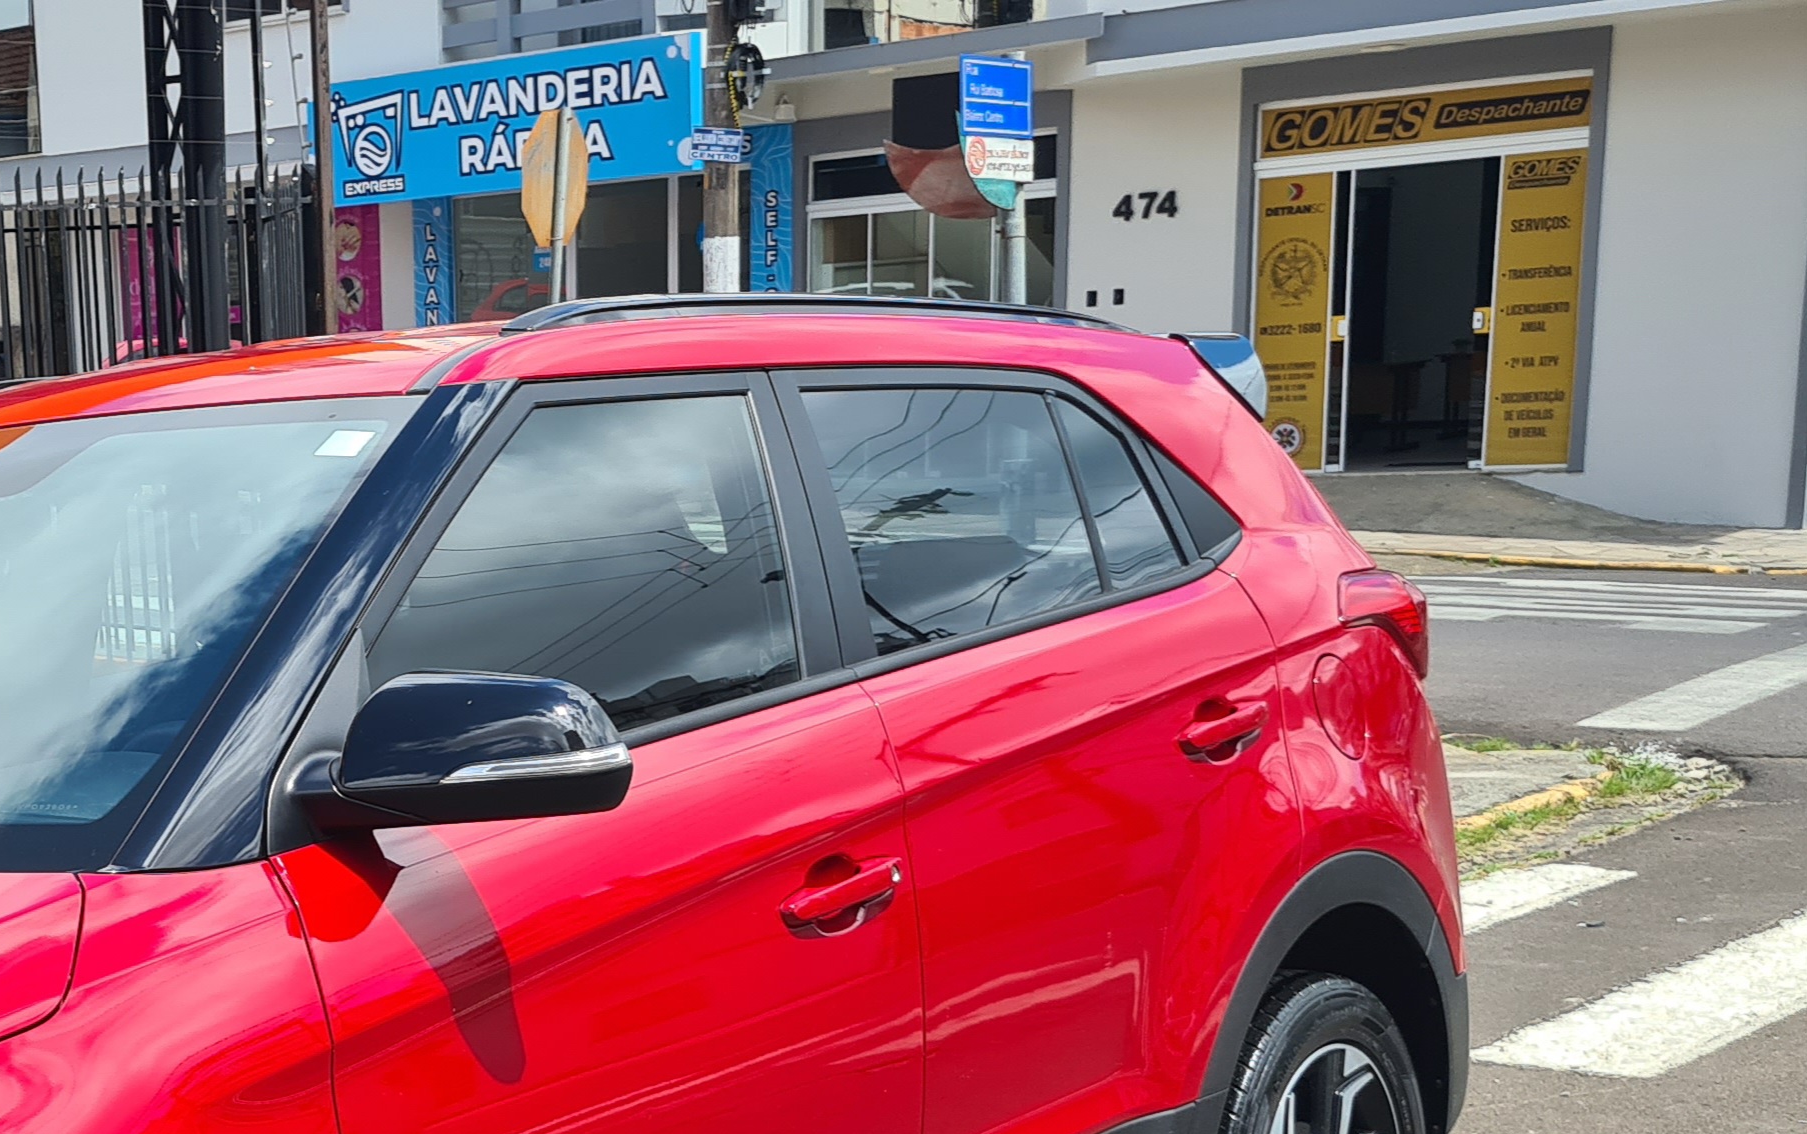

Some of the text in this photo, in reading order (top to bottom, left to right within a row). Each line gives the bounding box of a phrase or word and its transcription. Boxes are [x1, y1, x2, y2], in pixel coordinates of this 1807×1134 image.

[408, 59, 666, 129] LAVANDERIA
[1268, 94, 1584, 150] GOMES Despachante
[459, 120, 613, 175] RÁA
[1509, 156, 1581, 179] GOMES
[345, 177, 405, 197] EXPRESS
[1112, 189, 1179, 222] 474
[765, 190, 779, 292] SELF-
[1510, 215, 1572, 233] SERVIÇOS:
